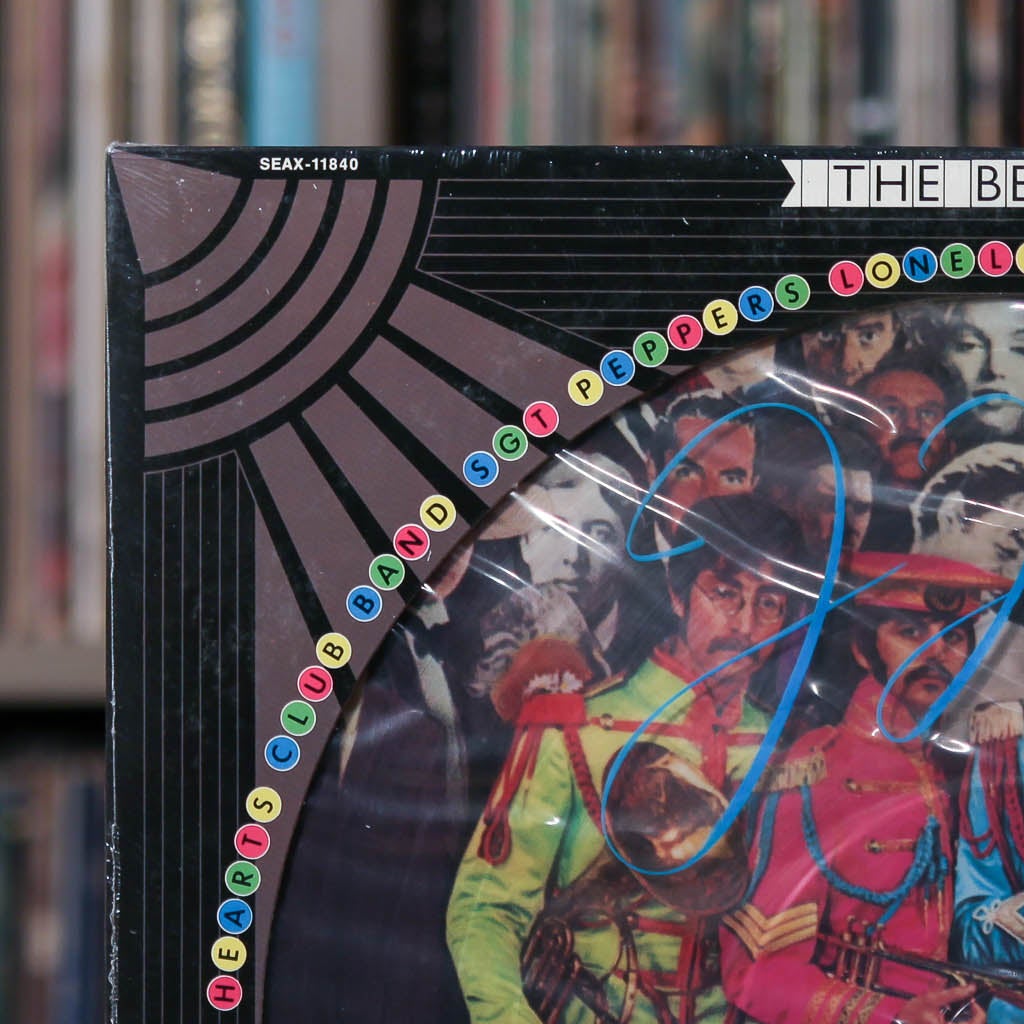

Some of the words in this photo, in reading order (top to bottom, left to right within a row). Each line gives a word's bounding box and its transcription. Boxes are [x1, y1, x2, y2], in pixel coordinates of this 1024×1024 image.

[259, 157, 359, 171] SEAX-11840
[833, 165, 940, 202] THE
[470, 408, 548, 481] SGT
[574, 281, 801, 401] PEPPERS
[213, 796, 275, 1004] HEARTS
[271, 641, 345, 764] CLUB
[351, 501, 449, 615] BAND
